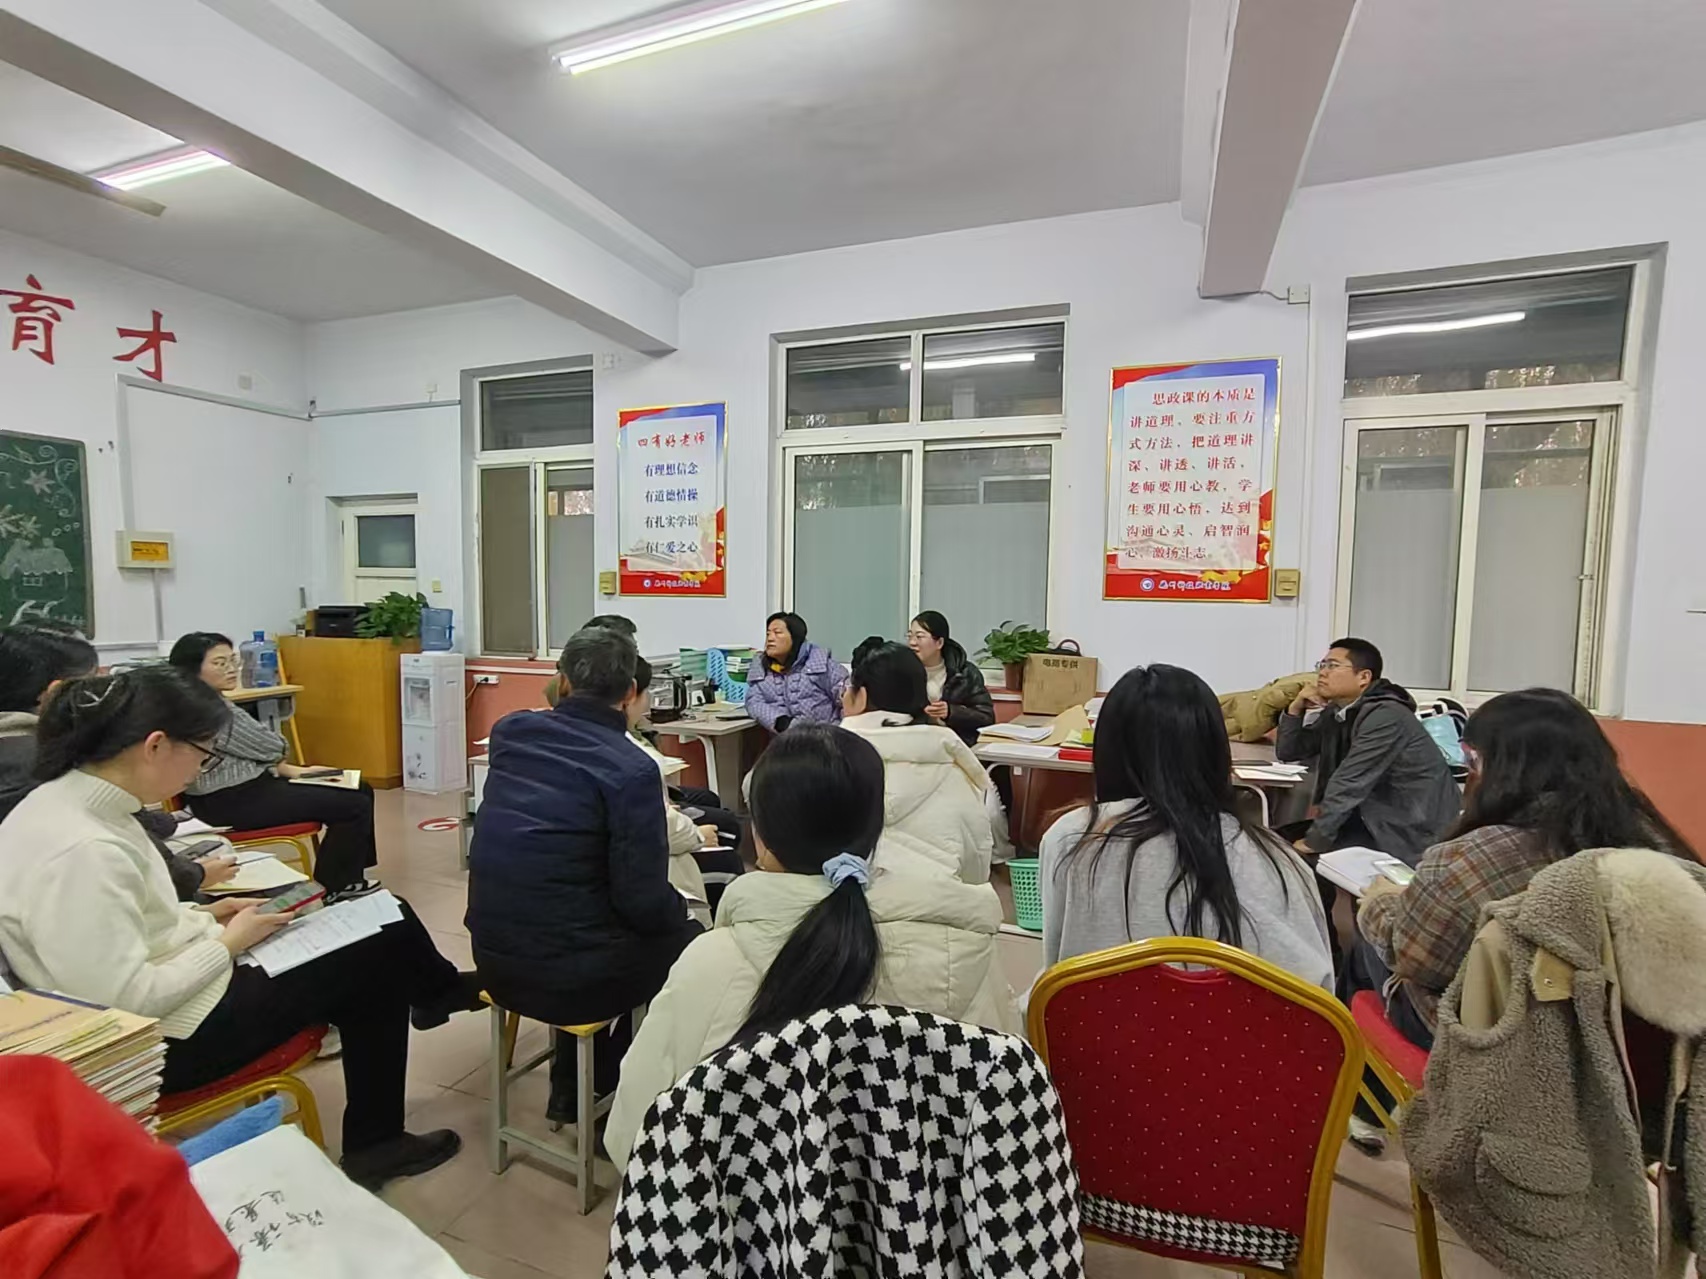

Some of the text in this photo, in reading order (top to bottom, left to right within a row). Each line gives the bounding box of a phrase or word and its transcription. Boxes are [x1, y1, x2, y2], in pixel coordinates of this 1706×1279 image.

[1152, 388, 1255, 405] 思政课的本质是
[638, 431, 705, 448] 四有好老师
[645, 462, 698, 477] 有理想信念
[645, 488, 698, 503] 有道德情操
[645, 514, 698, 529] 有扎实学识
[645, 540, 698, 554] 有仁爱之心
